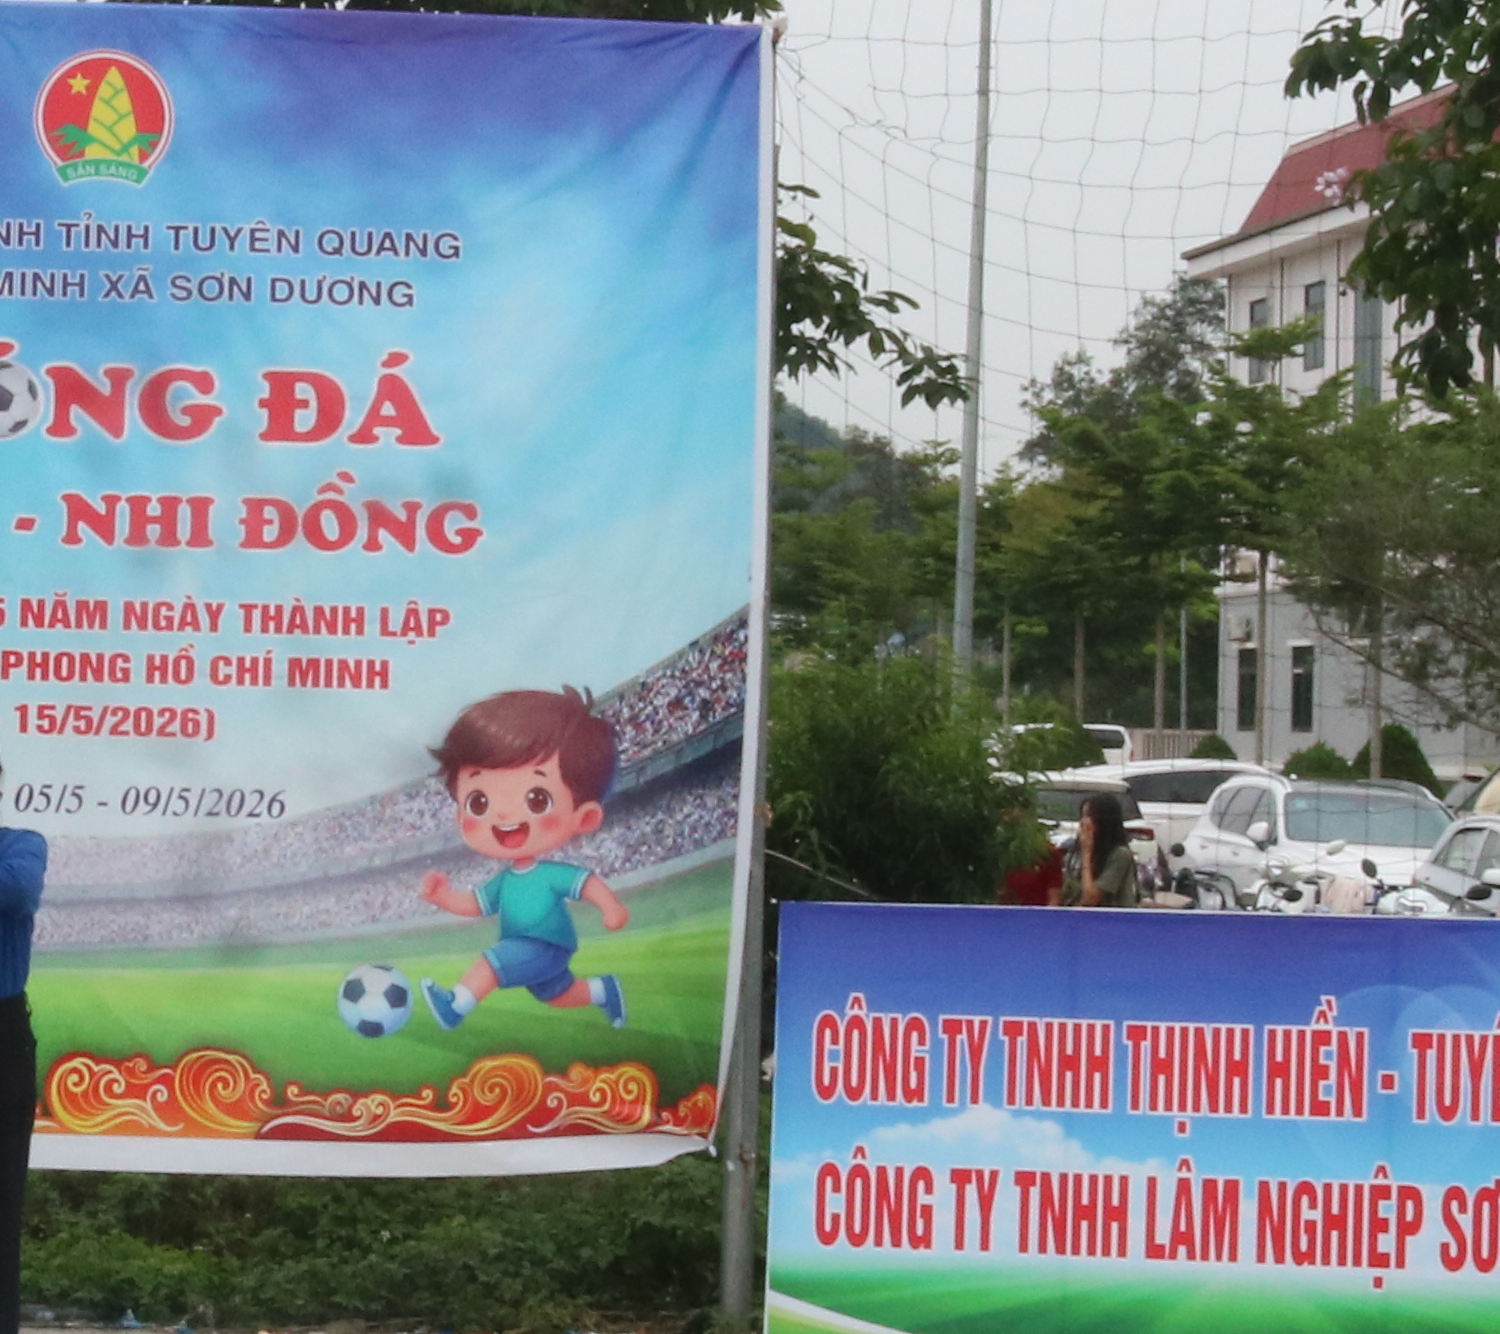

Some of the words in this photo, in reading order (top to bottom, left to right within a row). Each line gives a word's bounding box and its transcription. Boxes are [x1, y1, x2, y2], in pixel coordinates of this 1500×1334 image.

[57, 211, 150, 251] TỈNH
[167, 219, 300, 255] TUYÊN
[317, 229, 461, 260] QUANG
[101, 266, 155, 301] XÃ
[170, 273, 253, 303] SƠN
[270, 275, 416, 308] DƯƠNG
[258, 351, 441, 446] ĐÁ
[14, 516, 37, 532] -
[60, 492, 215, 548] NHI
[238, 470, 484, 555] ĐỒNG
[19, 592, 109, 631] NĂM
[122, 597, 226, 634] NGÀY
[239, 598, 366, 637] THÀNH
[378, 600, 452, 645] LẬP
[0, 649, 132, 684] PHONG
[146, 643, 198, 686] HỒ
[209, 650, 274, 687] CHÍ
[287, 656, 391, 690] MINH
[14, 704, 216, 741] 15/5/2026)
[14, 783, 87, 815] 05/5
[120, 785, 287, 820] 09/5/2026
[813, 996, 928, 1104] CÔNG
[941, 1018, 989, 1105] TY
[1002, 1020, 1112, 1110] TNHH
[1125, 1024, 1251, 1135] THỊNH
[1264, 998, 1366, 1119] HIỀN
[1380, 1074, 1395, 1091] -
[814, 1146, 934, 1249] CÔNG
[950, 1169, 999, 1252] TY
[1014, 1171, 1130, 1259] TNHH
[1144, 1158, 1240, 1263] LÂM
[1256, 1165, 1424, 1290] NGHIỆP
